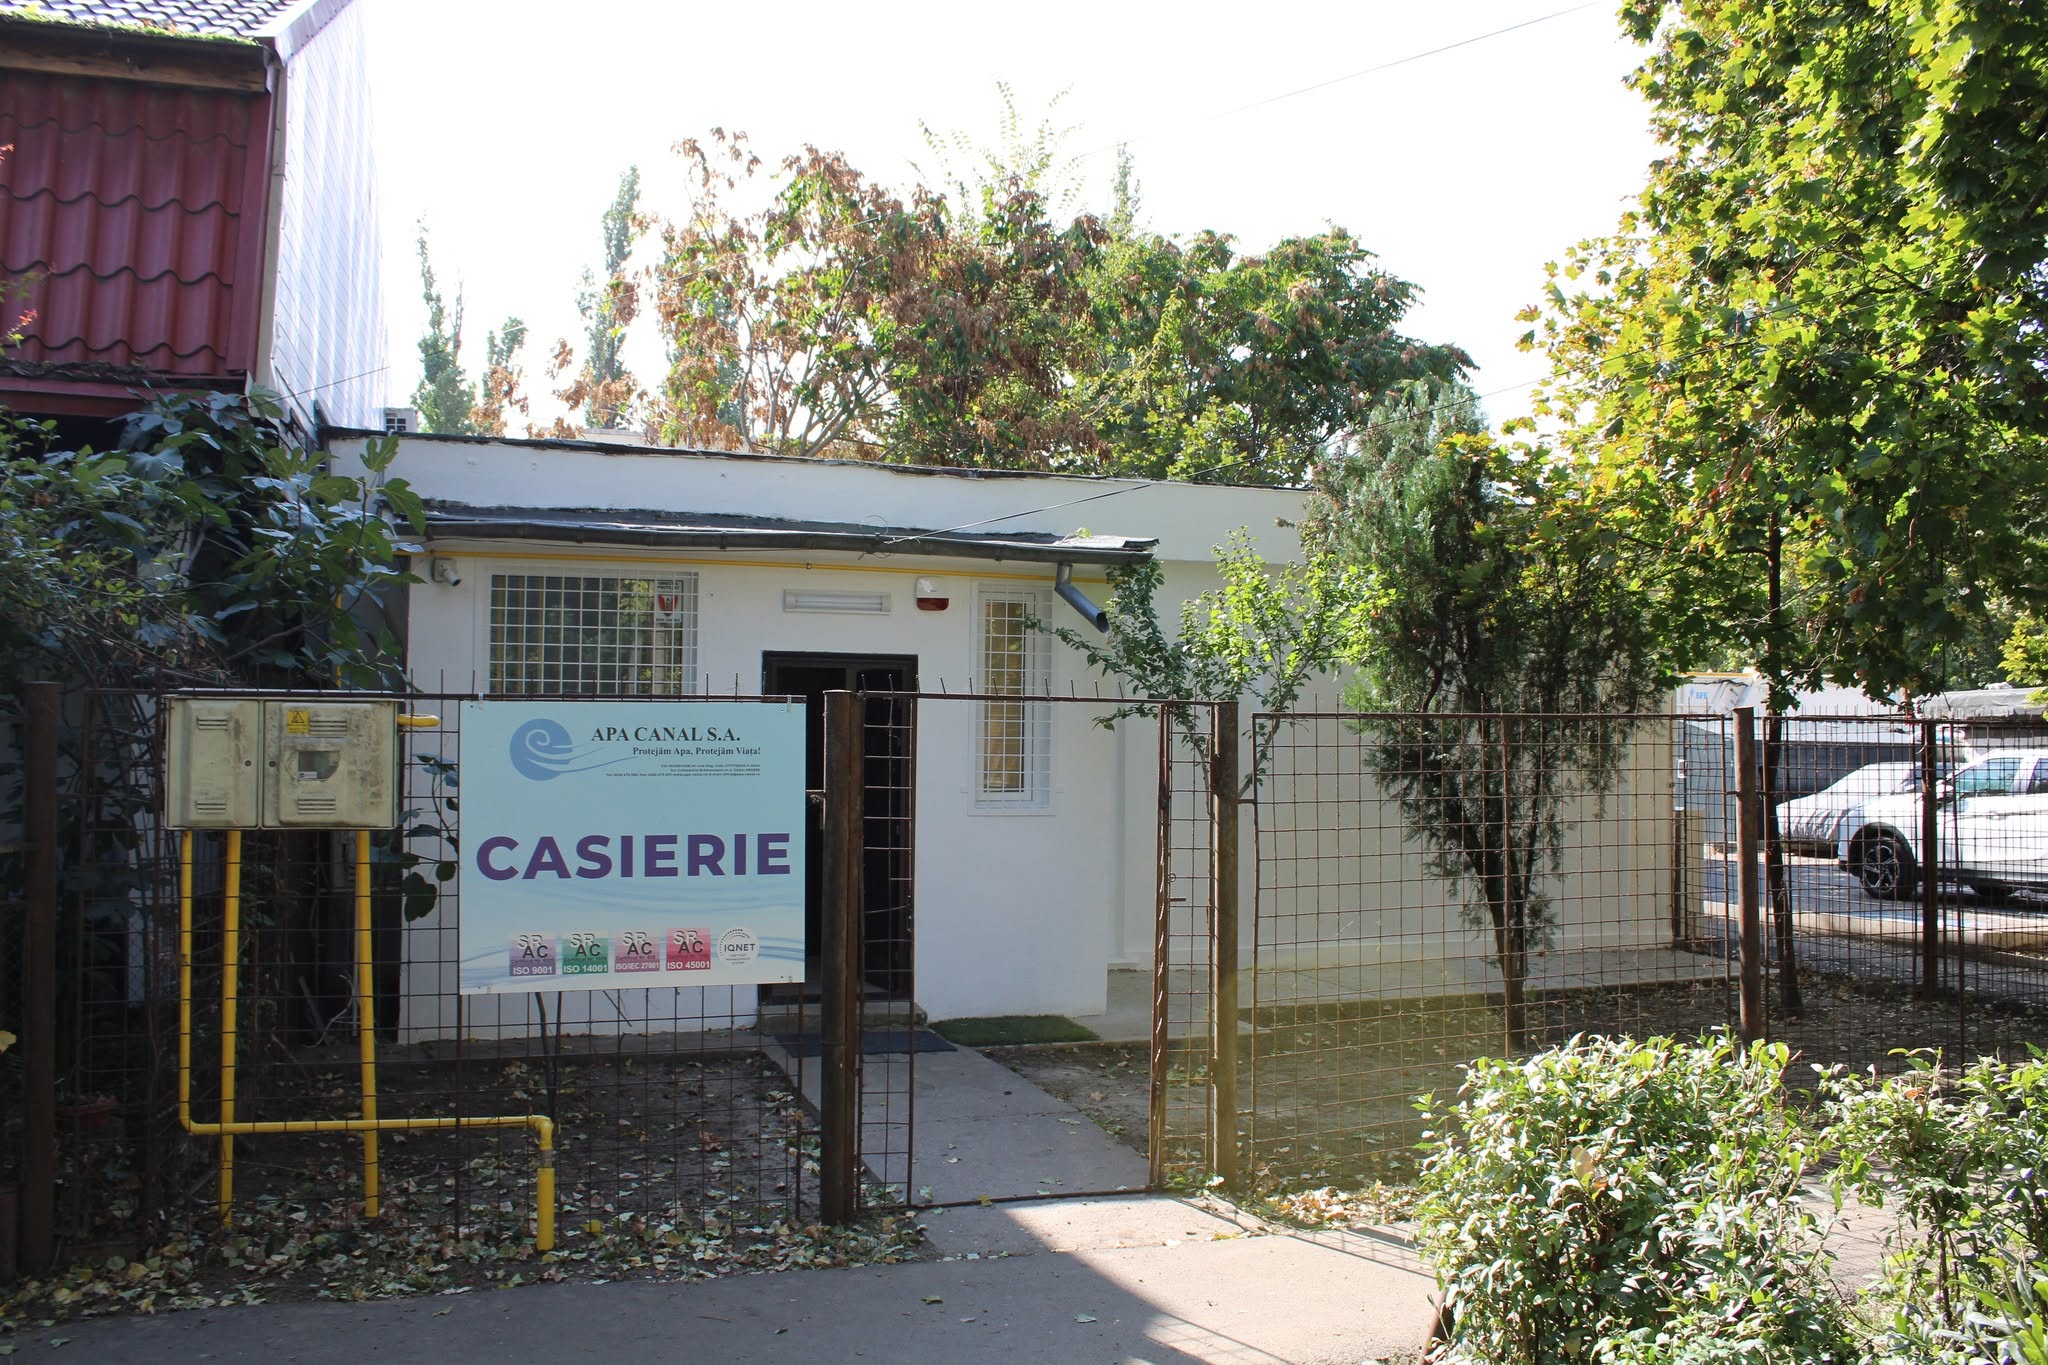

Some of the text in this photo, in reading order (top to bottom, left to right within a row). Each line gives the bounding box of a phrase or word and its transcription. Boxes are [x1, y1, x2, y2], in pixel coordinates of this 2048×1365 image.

[592, 726, 740, 742] APA CANAL S.A.
[633, 747, 672, 756] Protejăm
[674, 746, 693, 756] Apa,
[696, 746, 734, 756] Protejăm
[476, 833, 790, 881] CASIERIE
[724, 944, 756, 952] IQNET
